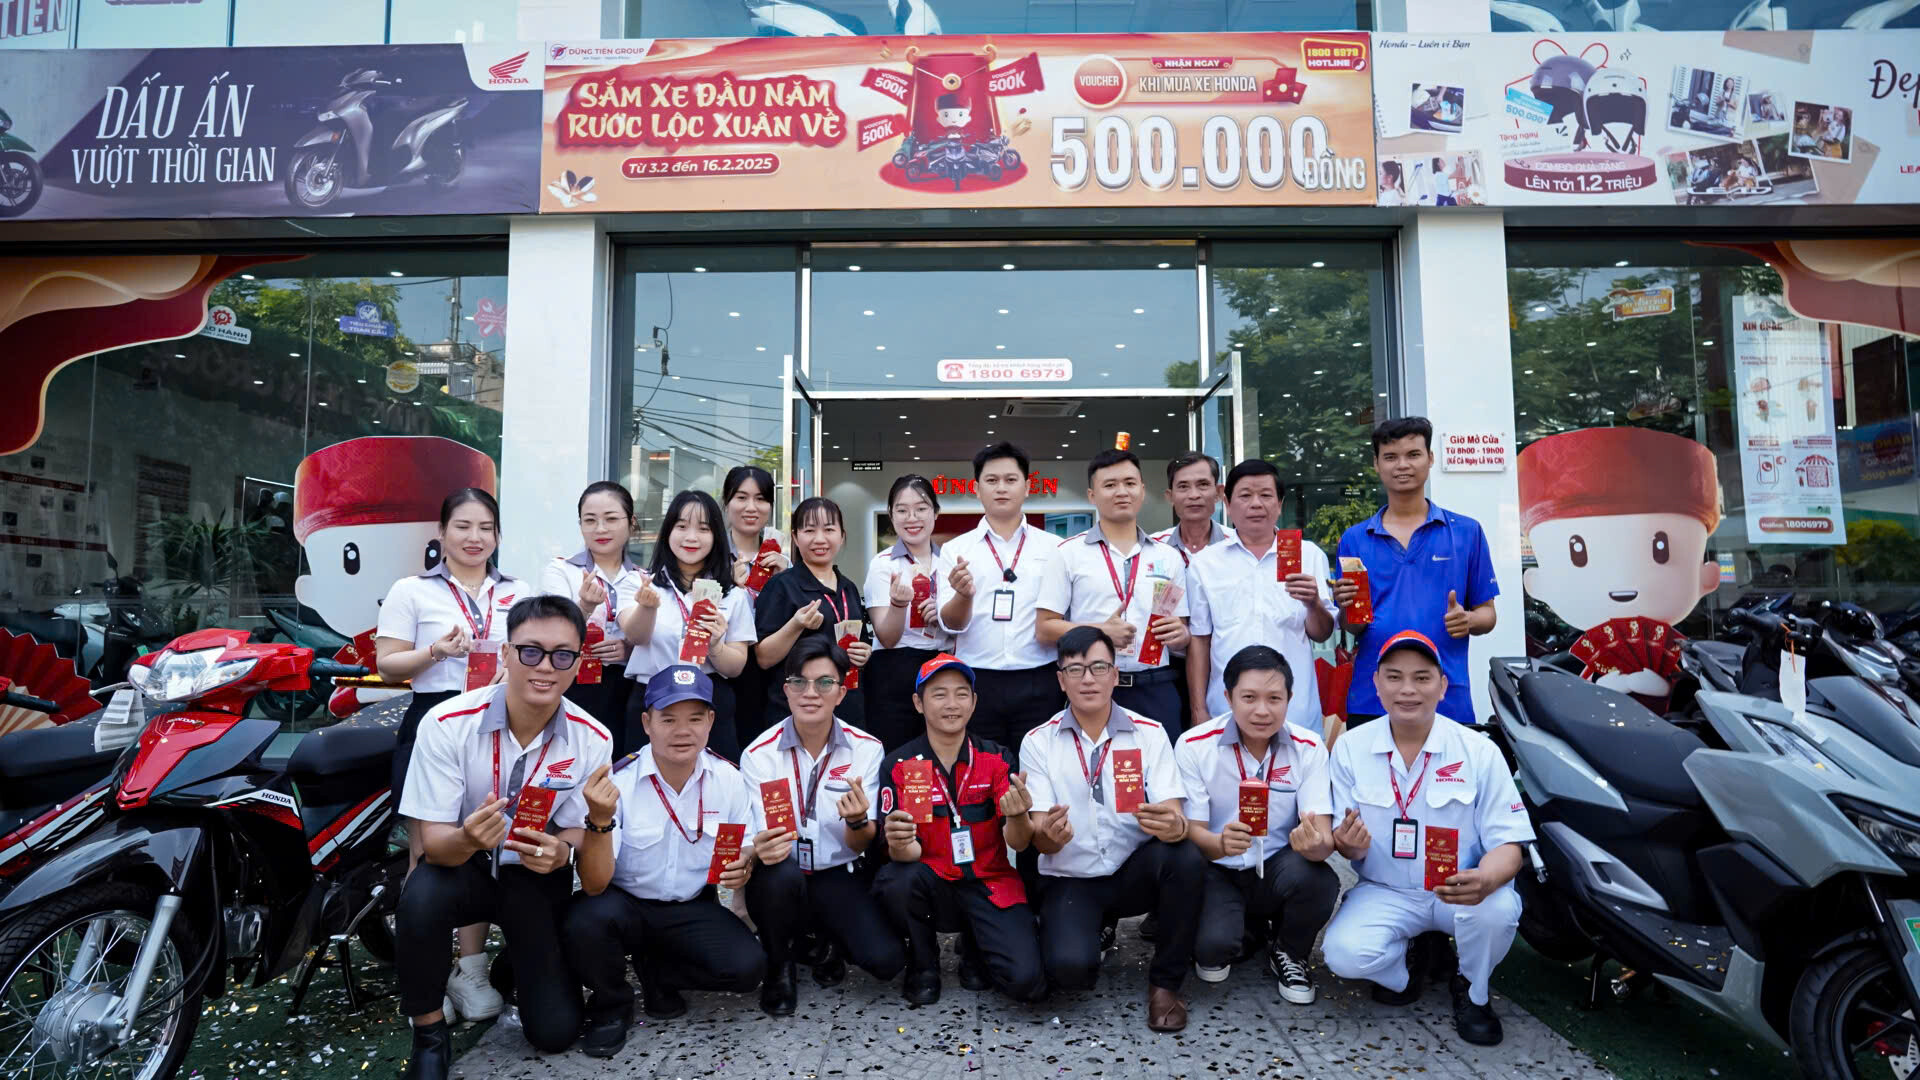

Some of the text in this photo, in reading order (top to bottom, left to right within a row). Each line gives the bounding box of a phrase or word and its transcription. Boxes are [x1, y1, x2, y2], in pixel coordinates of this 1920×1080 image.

[1307, 48, 1331, 57] 1800
[1379, 39, 1408, 49] Honda
[1418, 39, 1439, 49] Luôn
[1452, 40, 1470, 50] Bạn
[1165, 58, 1220, 69] NHẬN NGAY
[1308, 59, 1350, 67] HOTLINE
[874, 77, 908, 99] 500K
[988, 71, 1026, 92] 500K
[1079, 75, 1119, 87] VOUCHER
[1139, 76, 1257, 93] KHI MUA XE HONDA
[580, 77, 830, 107] SẮM XE ĐẦU NĂM
[96, 72, 254, 139] DẤU ẤN
[652, 111, 704, 142] LỘC
[712, 112, 792, 138] XUÂN
[800, 108, 840, 137] VỀ
[862, 121, 893, 145] 500K
[1050, 115, 1367, 191] 500.000 ĐỒNG
[72, 143, 276, 189] VƯỢT THỜI GIAN
[629, 158, 773, 174] Từ 3.2 đến 16.2.2025
[1525, 174, 1642, 192] LÊN TỚI 1.2 TRIỆU
[969, 369, 1065, 378] 1800 6979
[1450, 434, 1499, 444] Giờ Mở Cửa
[1028, 470, 1059, 494] ẾN
[1785, 520, 1828, 529] 18006979
[261, 792, 292, 804] HONDA
